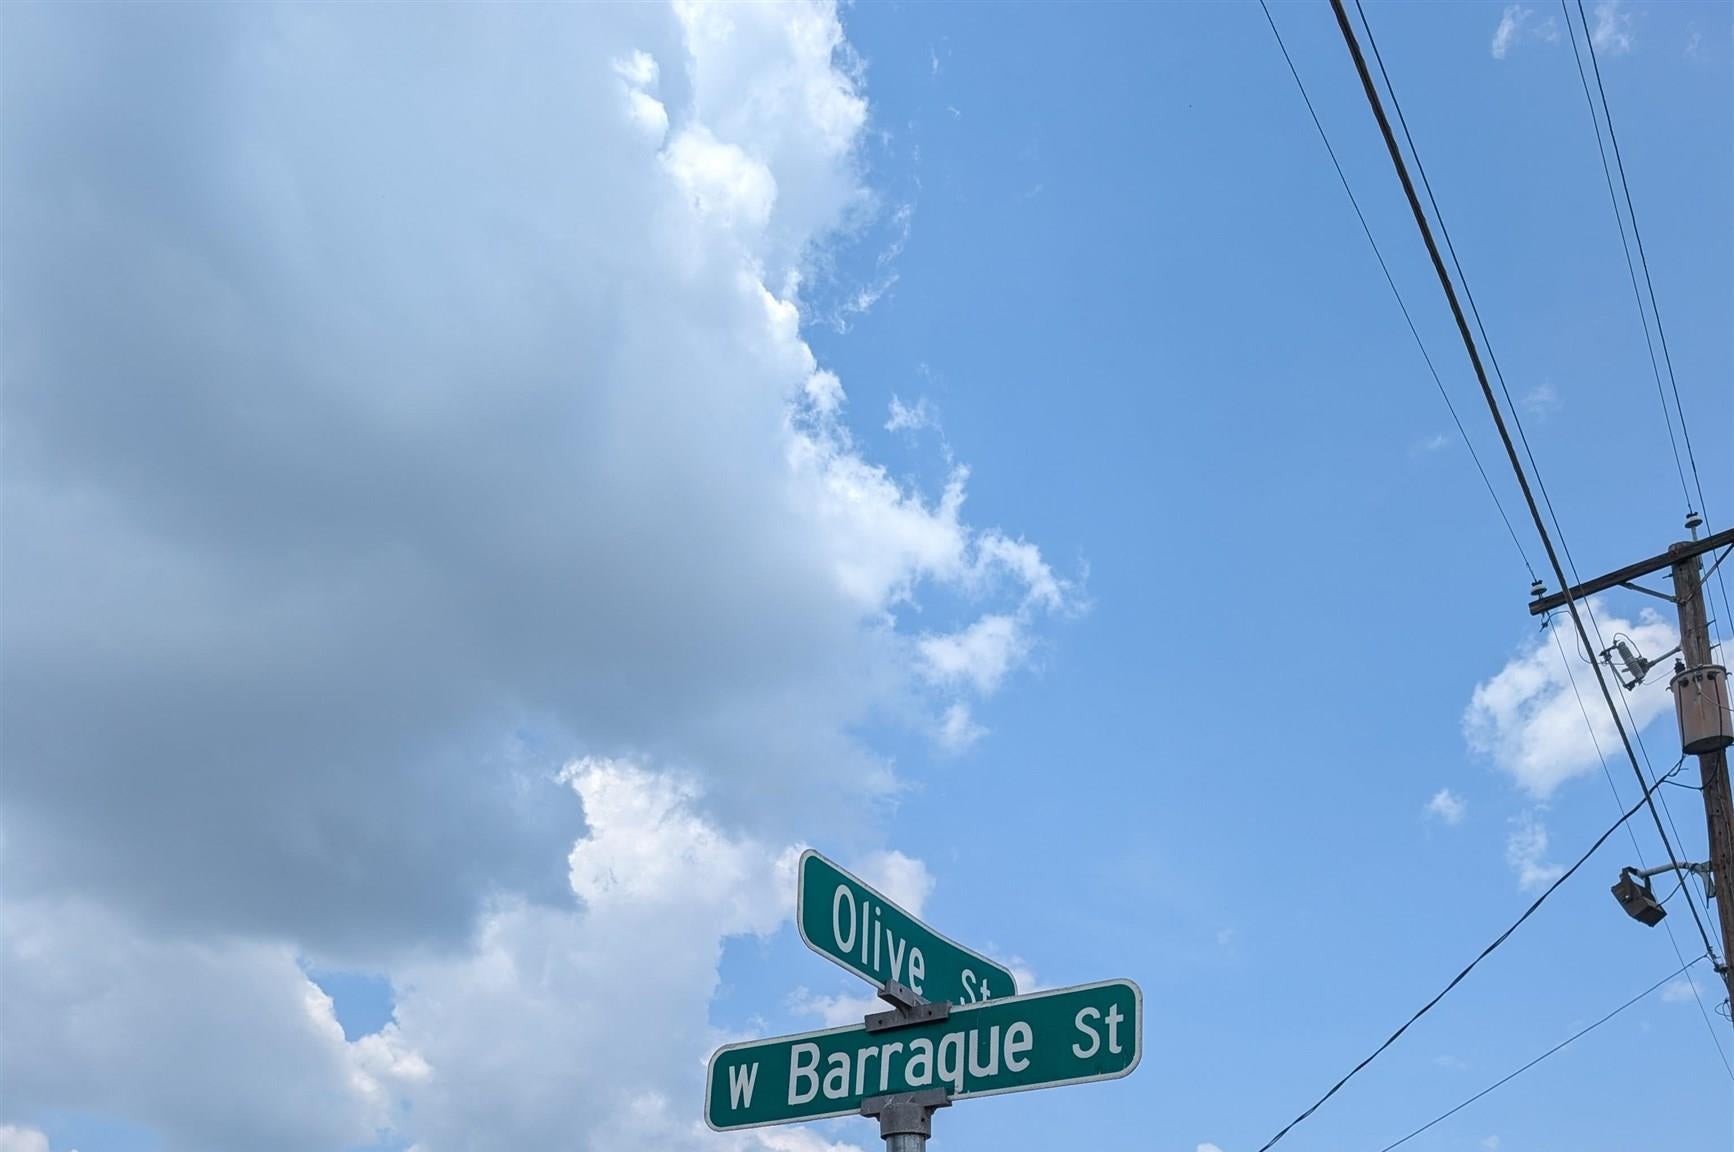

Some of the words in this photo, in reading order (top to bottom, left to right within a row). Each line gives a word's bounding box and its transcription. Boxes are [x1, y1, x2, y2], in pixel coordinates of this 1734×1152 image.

[832, 884, 925, 995] Olive
[960, 968, 991, 1006] St
[729, 1062, 759, 1110] W
[788, 1020, 1033, 1105] Barraque
[1072, 1002, 1125, 1059] St
